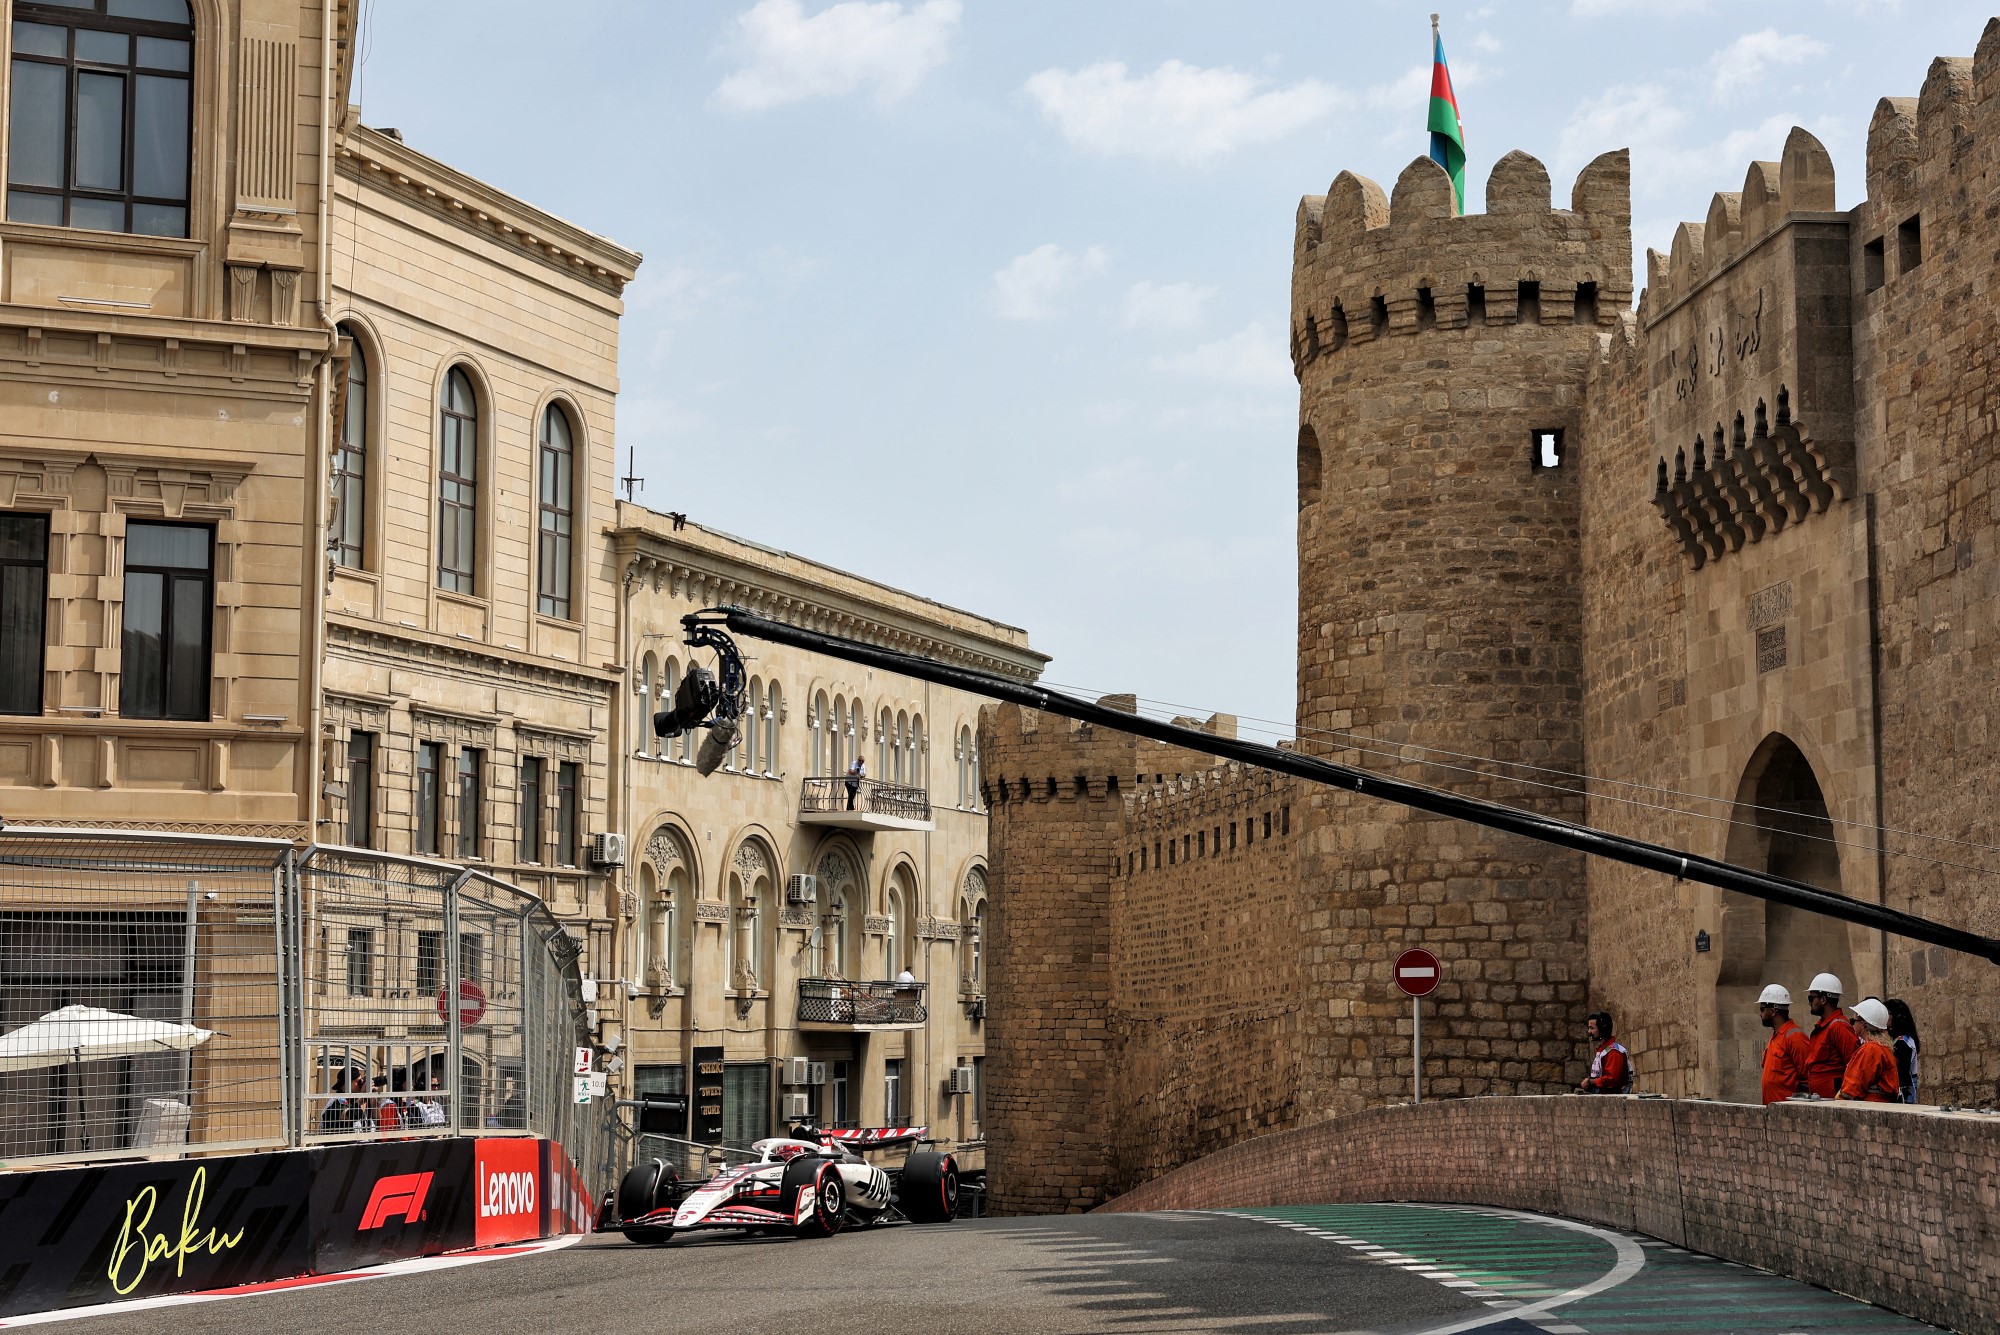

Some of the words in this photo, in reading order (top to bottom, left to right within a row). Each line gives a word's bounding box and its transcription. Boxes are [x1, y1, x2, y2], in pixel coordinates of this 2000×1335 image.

[701, 1086, 722, 1097] SWEET
[703, 1105, 721, 1116] HOME
[480, 1160, 535, 1218] Lenovo
[107, 1166, 245, 1295] Baku
